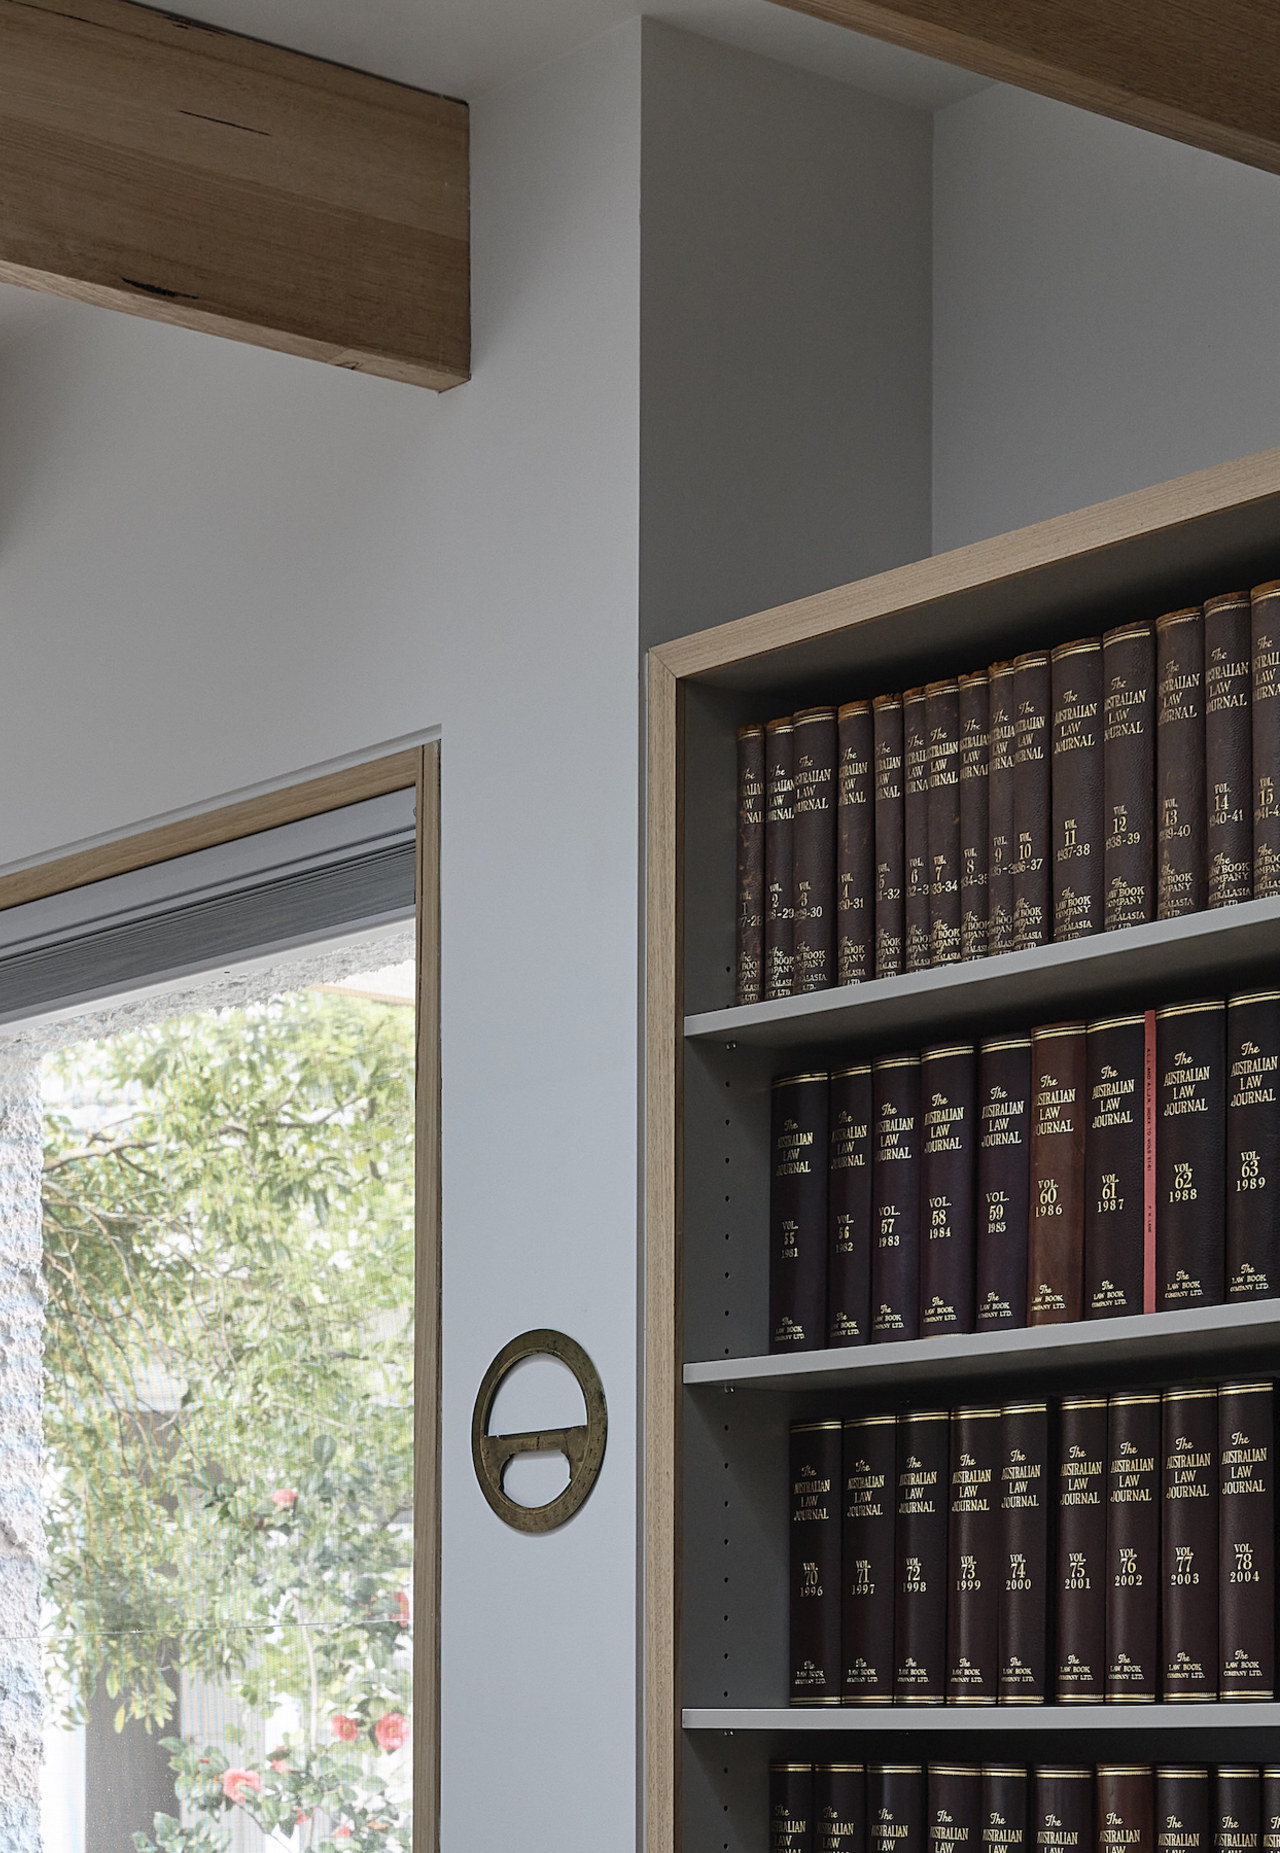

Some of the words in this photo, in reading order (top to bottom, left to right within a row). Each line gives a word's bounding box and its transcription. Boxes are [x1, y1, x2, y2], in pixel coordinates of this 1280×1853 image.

[1063, 690, 1078, 704] The
[1054, 702, 1097, 726] AUSTRALIAN
[1061, 721, 1081, 737] LAW
[1054, 734, 1095, 754] JOURNAL
[1065, 831, 1076, 847] 11
[1056, 844, 1090, 863] 1937-38
[1241, 1041, 1260, 1056] The
[1174, 1051, 1193, 1066] The
[1231, 1056, 1278, 1077] AUSTRALIAN
[1101, 1065, 1118, 1079] The
[1164, 1066, 1210, 1087] AUSTRALIAN
[1092, 1079, 1135, 1099] AUSTRALIAN
[1240, 1075, 1263, 1090] LAW
[1173, 1085, 1196, 1100] LAW
[1231, 1088, 1276, 1107] JOURNAL
[1100, 1097, 1121, 1113] LAW
[1164, 1098, 1208, 1116] JOURNAL
[1092, 1111, 1133, 1129] JOURNAL
[1241, 1160, 1259, 1178] 63
[1175, 1172, 1192, 1189] 62
[1236, 1177, 1266, 1191] 1989
[1102, 1183, 1117, 1200] 61
[1169, 1188, 1197, 1203] 1988
[1098, 1199, 1124, 1213] 1987
[1175, 1436, 1194, 1451] The
[1232, 1431, 1250, 1446] The
[1120, 1441, 1138, 1456] The
[1222, 1448, 1267, 1465] AUSTRALIAN
[1110, 1458, 1154, 1474] AUSTRALIAN
[1166, 1453, 1211, 1470] AUSTRALIAN
[1175, 1470, 1196, 1484] LAW
[1231, 1465, 1253, 1479] LAW
[1120, 1474, 1140, 1488] LAW
[1222, 1479, 1266, 1495] JOURNAL
[1110, 1488, 1152, 1503] JOURNAL
[1166, 1484, 1209, 1500] JOURNAL
[1234, 1544, 1253, 1553] VOL.
[1120, 1557, 1137, 1574] 76
[1176, 1557, 1192, 1573] 77
[1235, 1554, 1252, 1570] 78
[1114, 1574, 1143, 1587] 2002
[1171, 1573, 1200, 1585] 2003
[1230, 1570, 1260, 1583] 2004
[1166, 1815, 1183, 1828] The
[1158, 1833, 1200, 1847] AUSTRALIAN
